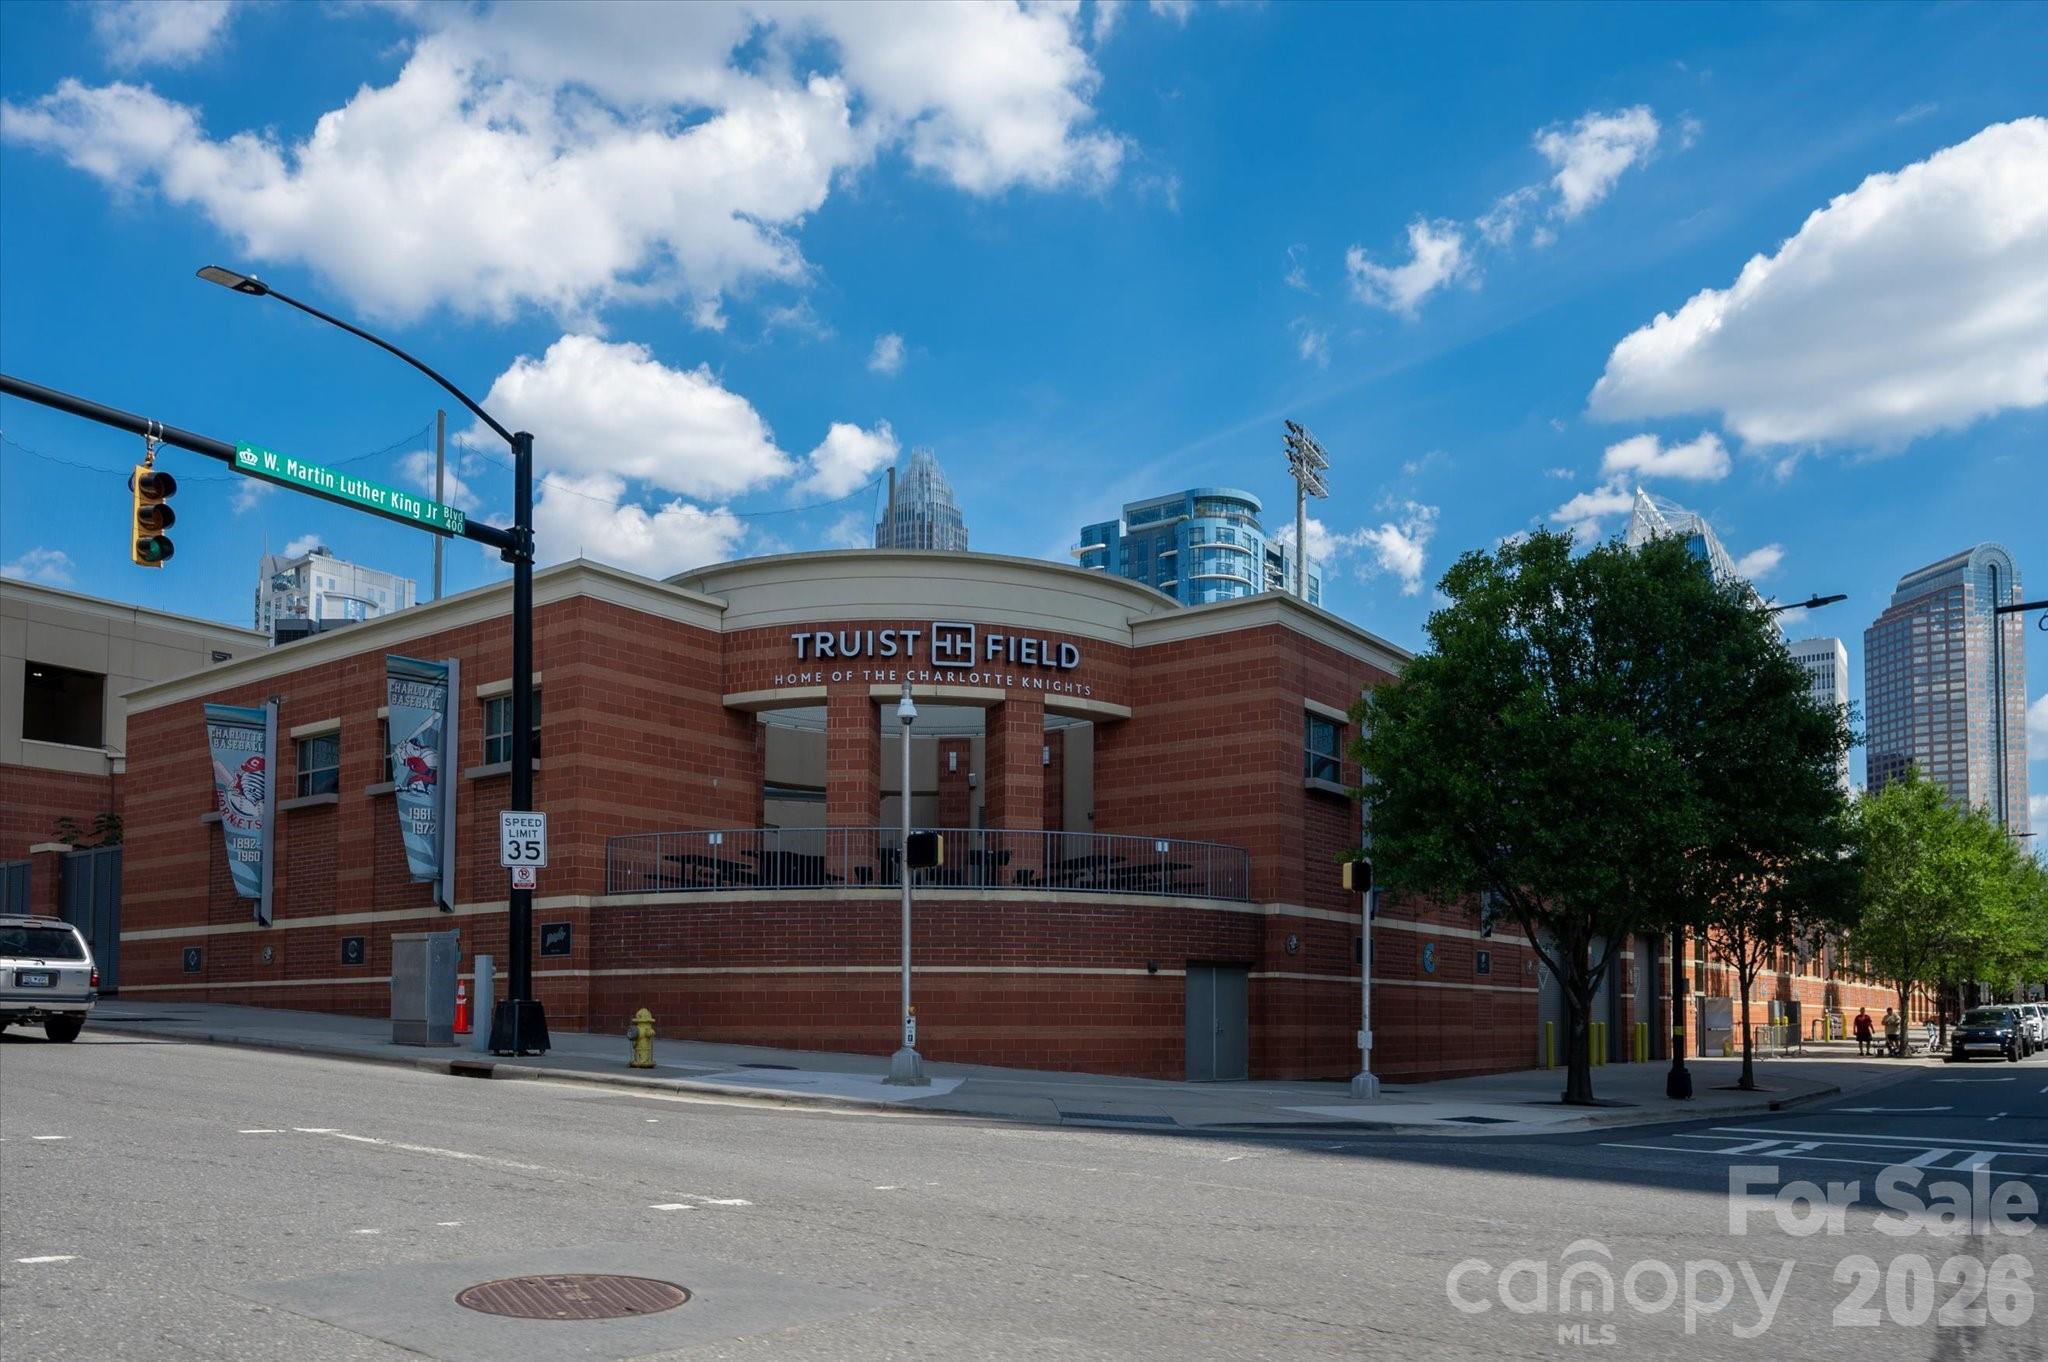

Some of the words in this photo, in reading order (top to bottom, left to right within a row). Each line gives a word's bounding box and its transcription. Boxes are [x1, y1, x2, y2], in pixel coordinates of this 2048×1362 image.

[263, 451, 280, 473] W.
[287, 458, 334, 489] Martin
[340, 476, 386, 504] Luther
[391, 492, 421, 519] King
[426, 503, 438, 520] Jr
[443, 506, 464, 522] Blvd
[445, 519, 463, 533] 400
[791, 629, 921, 659] TRUIST
[985, 634, 1080, 669] FIELD
[775, 671, 822, 685] HOME
[831, 670, 853, 682] OF
[863, 670, 896, 681] THE
[906, 670, 1013, 686] CHARLOTTE
[1022, 676, 1092, 696] KNIGHTS
[391, 694, 440, 710] BASEBALL
[211, 728, 264, 742] CHARLOTTE
[213, 739, 264, 752] BASEBALL
[216, 790, 264, 830] HORNETS
[505, 818, 542, 828] SPEED
[509, 829, 538, 838] LIMIT
[238, 850, 261, 862] 1960
[508, 840, 540, 860] 35
